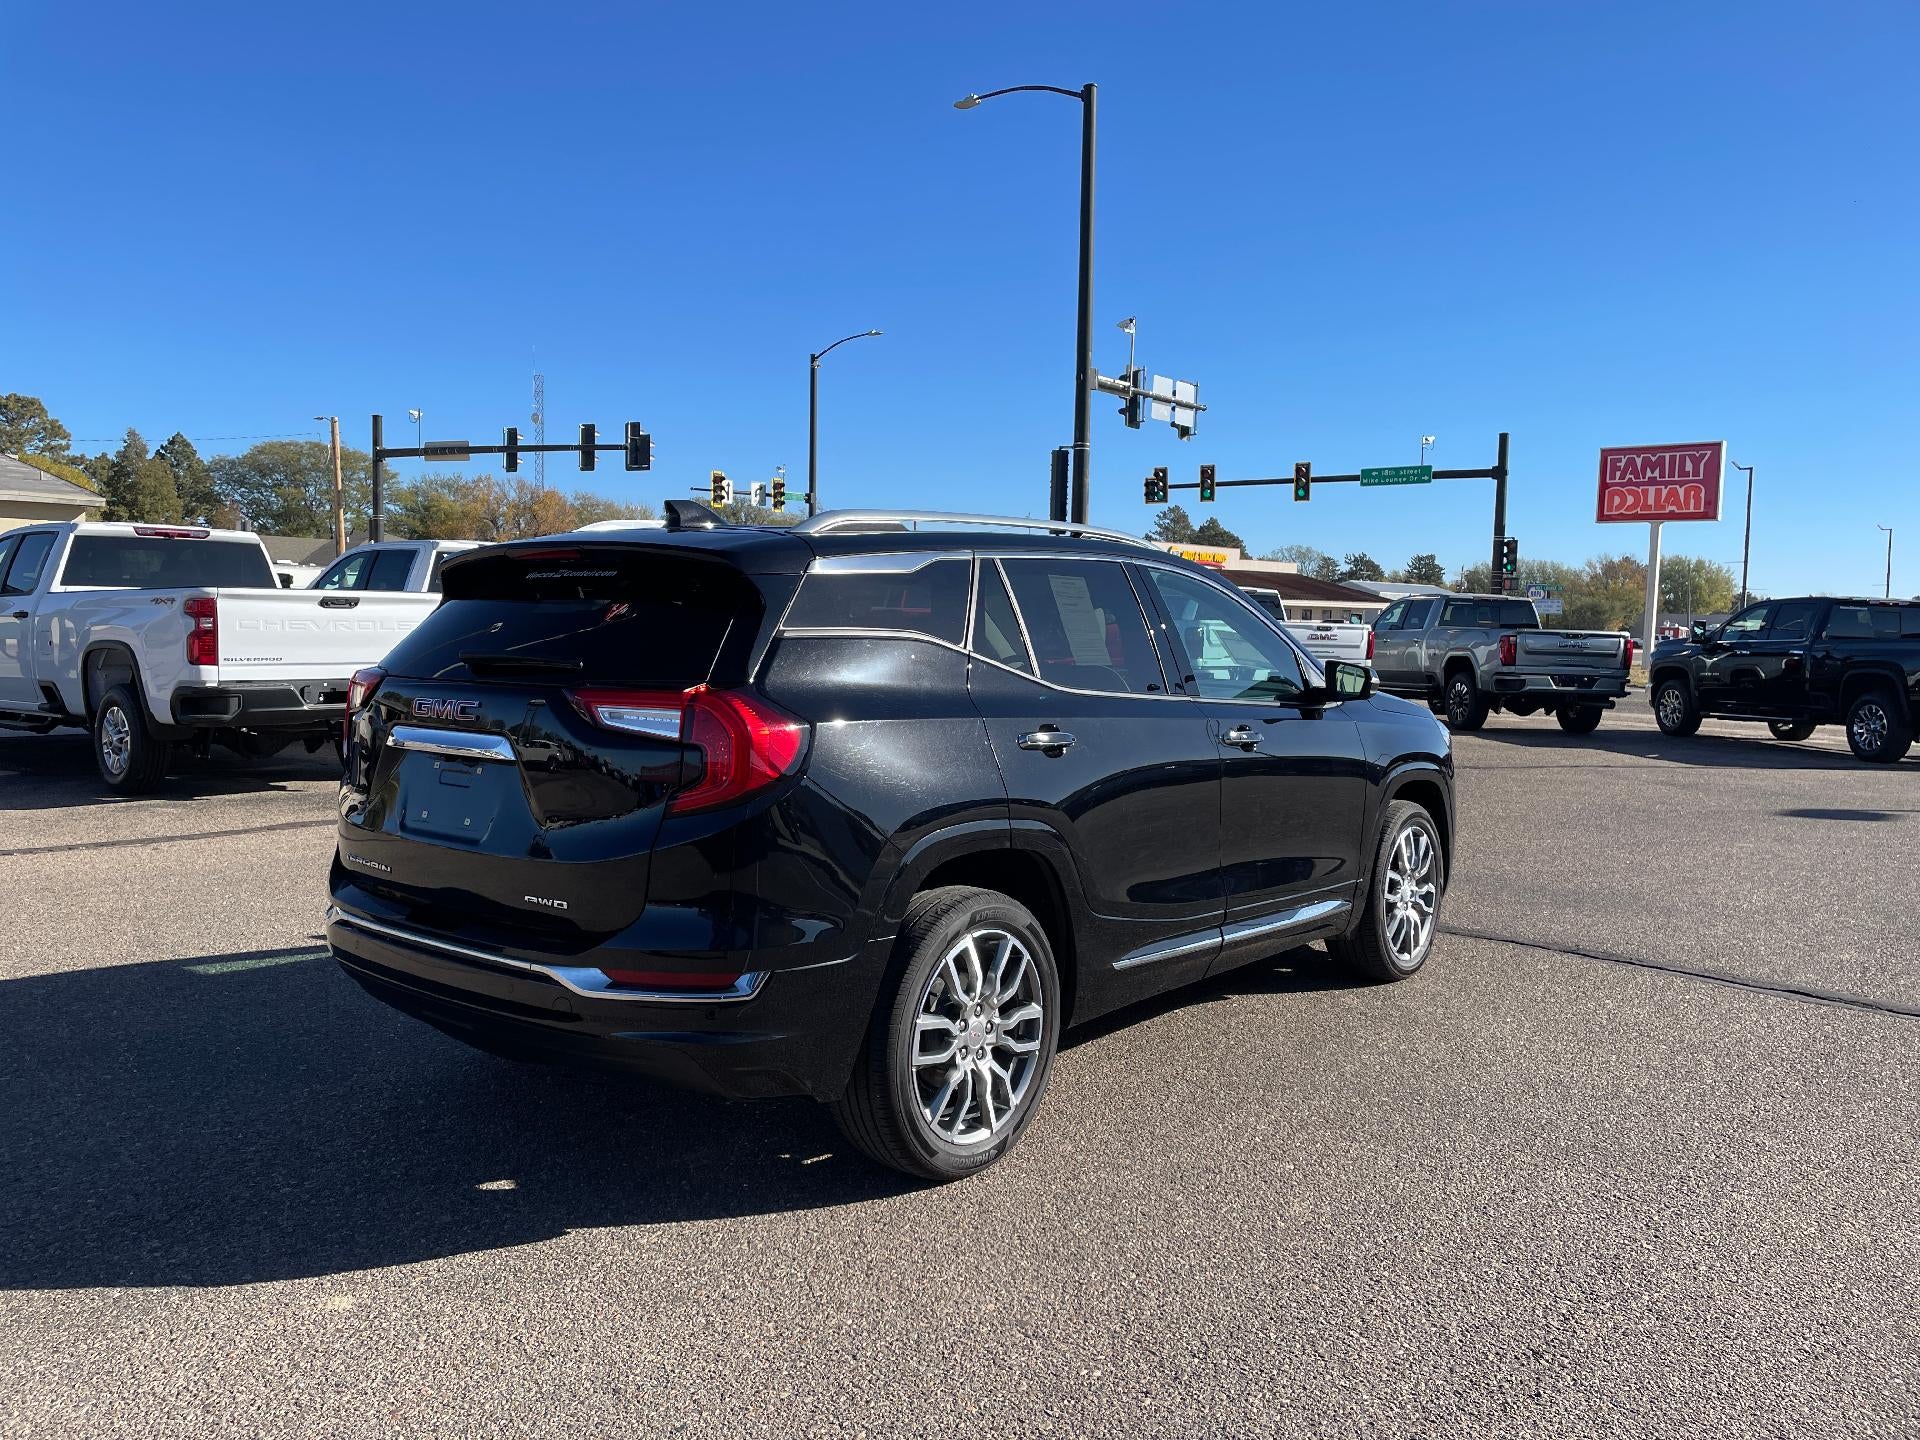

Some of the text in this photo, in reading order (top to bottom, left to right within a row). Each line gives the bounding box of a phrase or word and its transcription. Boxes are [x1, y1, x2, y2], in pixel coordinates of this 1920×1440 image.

[1606, 450, 1712, 483] FAMILY
[1604, 482, 1705, 515] DOLLAR
[235, 615, 424, 632] CHEVROLE
[1306, 632, 1339, 641] GMC
[412, 697, 481, 721] GMC
[524, 895, 568, 910] AWD
